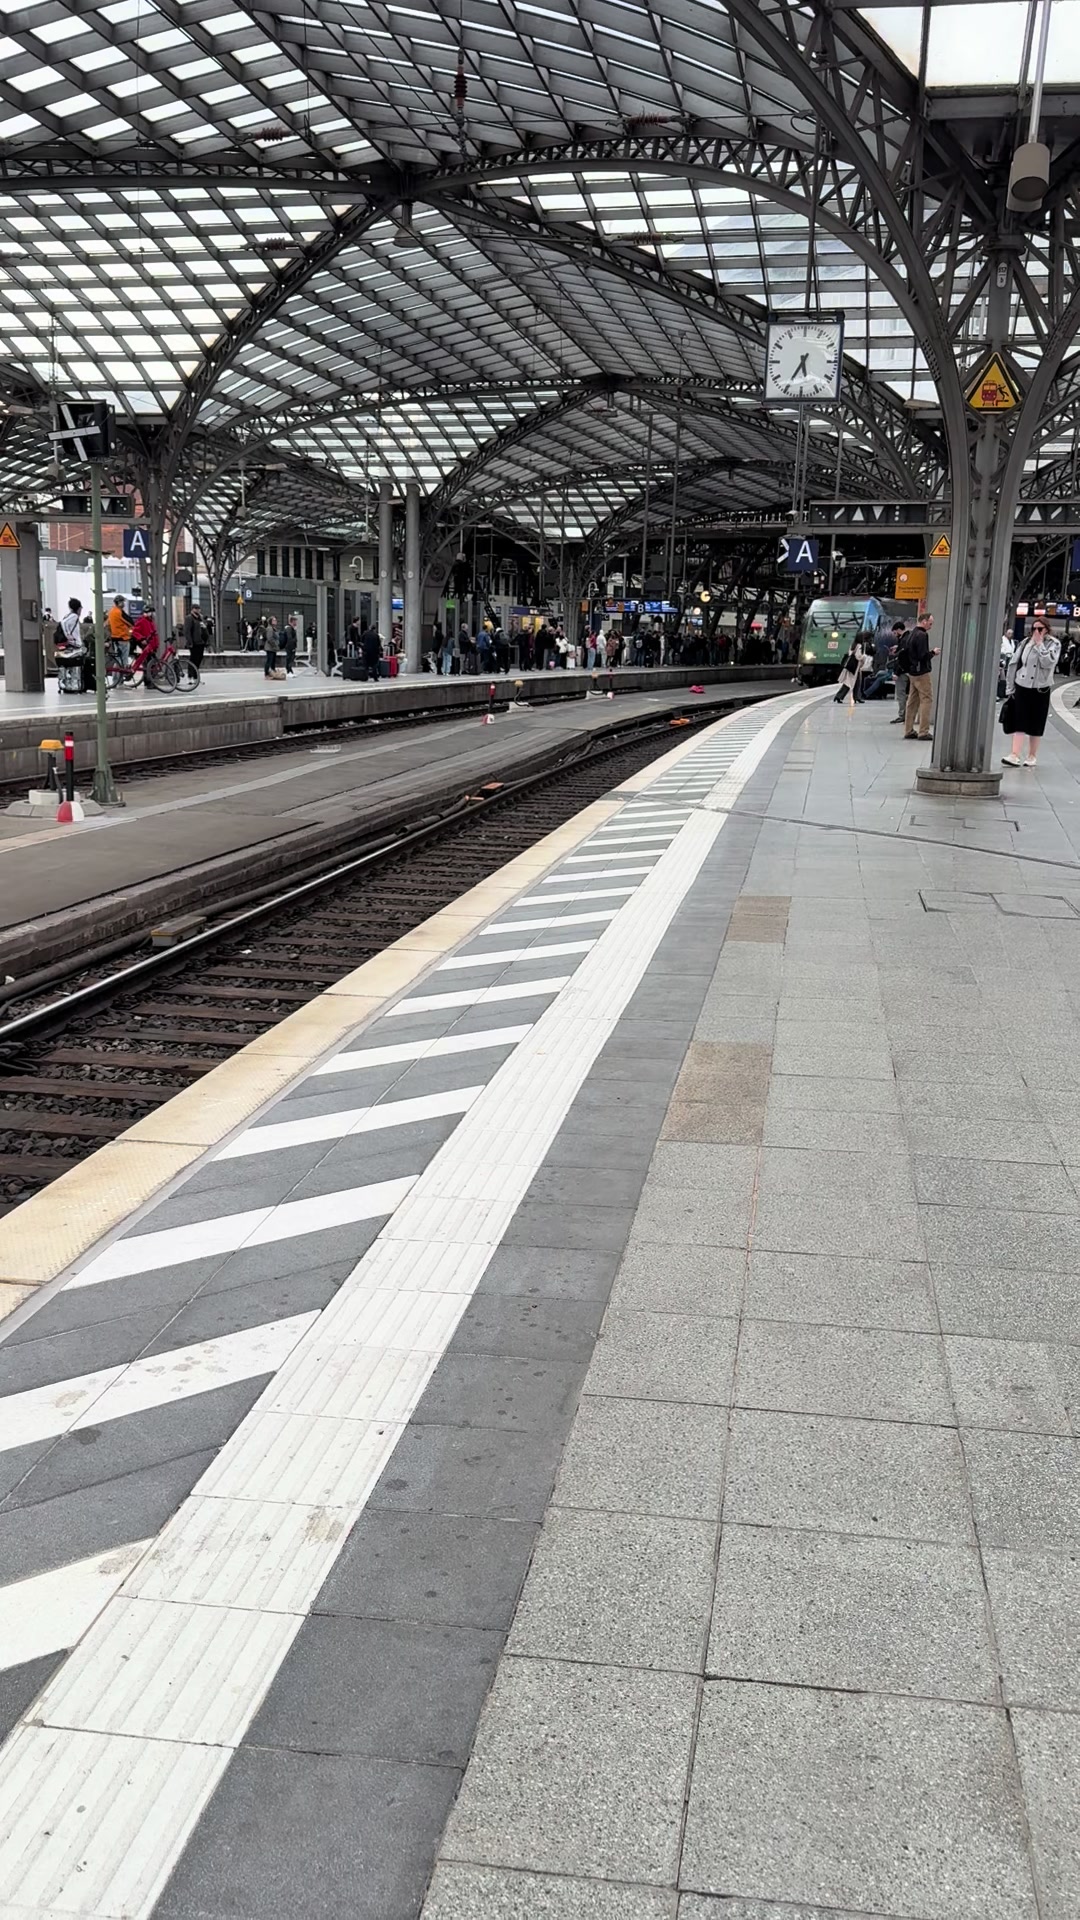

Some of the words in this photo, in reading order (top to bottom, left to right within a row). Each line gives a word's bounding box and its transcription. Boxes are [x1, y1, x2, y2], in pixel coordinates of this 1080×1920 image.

[130, 531, 146, 552] A
[795, 541, 813, 563] A
[246, 589, 252, 597] B
